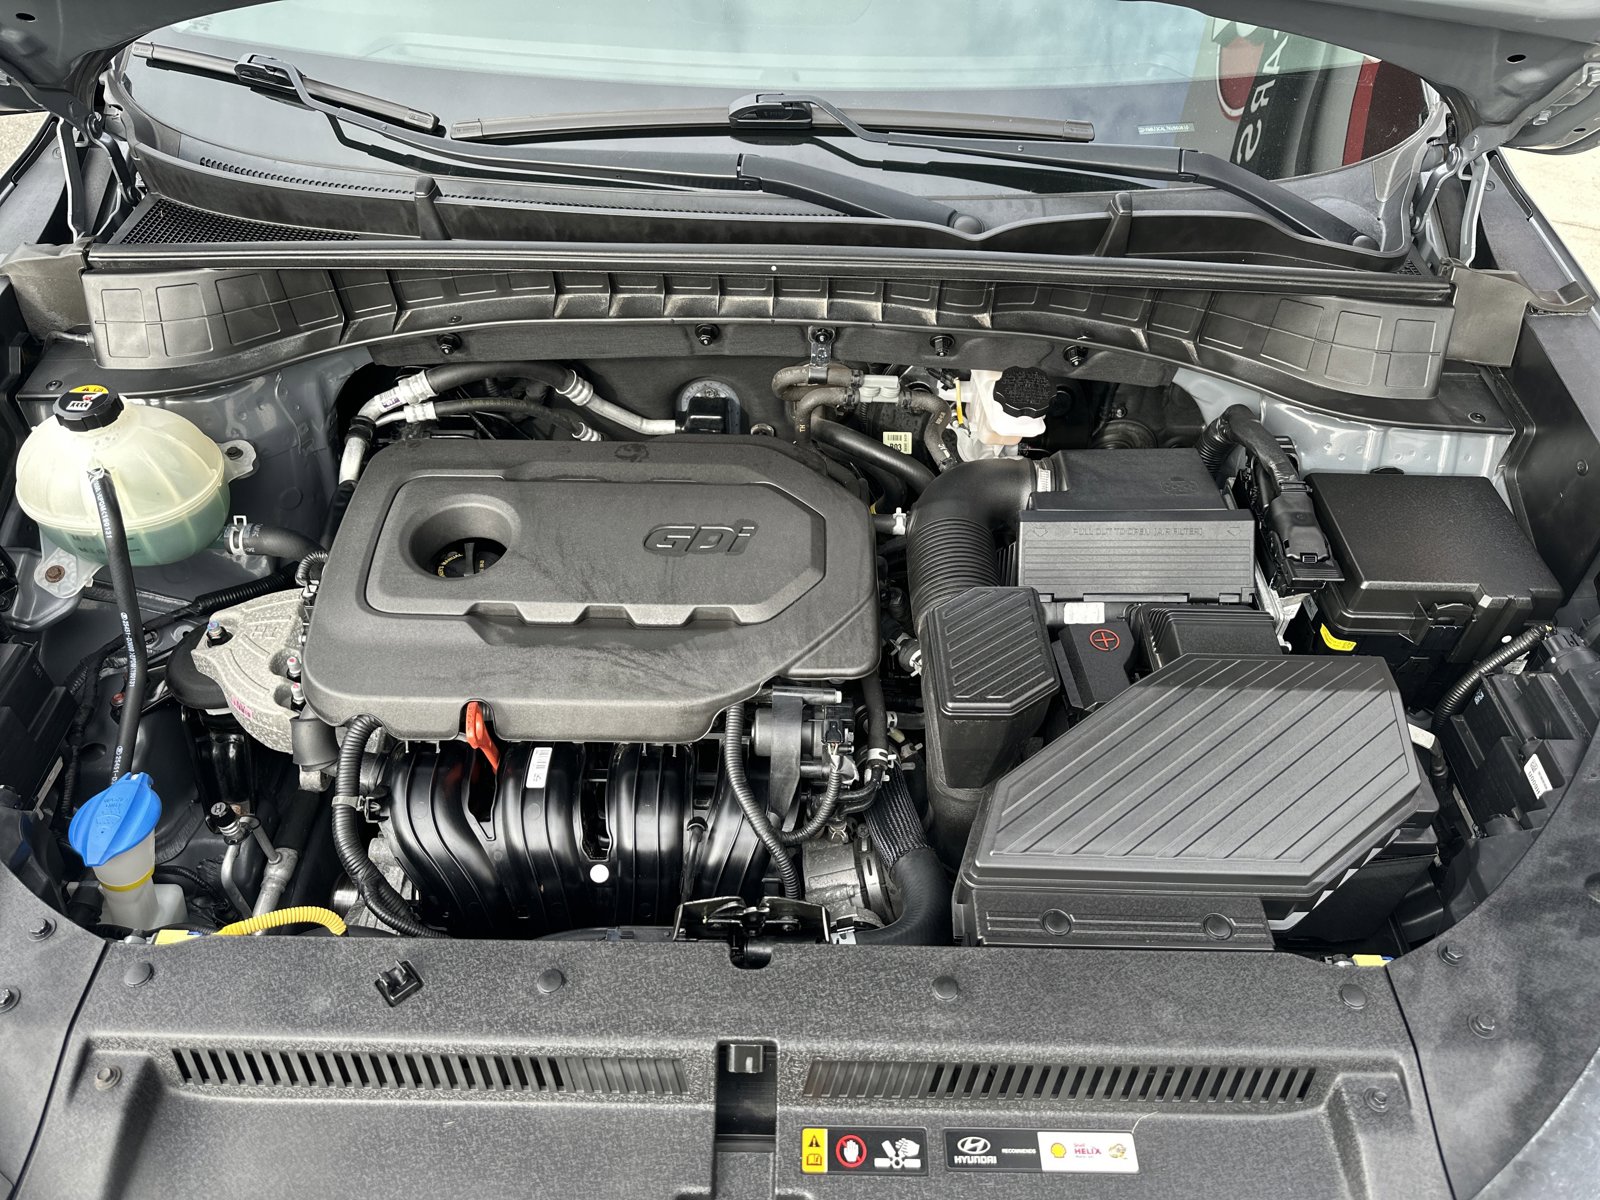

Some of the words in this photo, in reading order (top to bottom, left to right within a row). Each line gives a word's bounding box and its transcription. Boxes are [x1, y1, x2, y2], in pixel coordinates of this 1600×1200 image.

[1114, 527, 1125, 536] TO
[1074, 1147, 1102, 1155] HELIX
[953, 1155, 998, 1164] HYUNDAI
